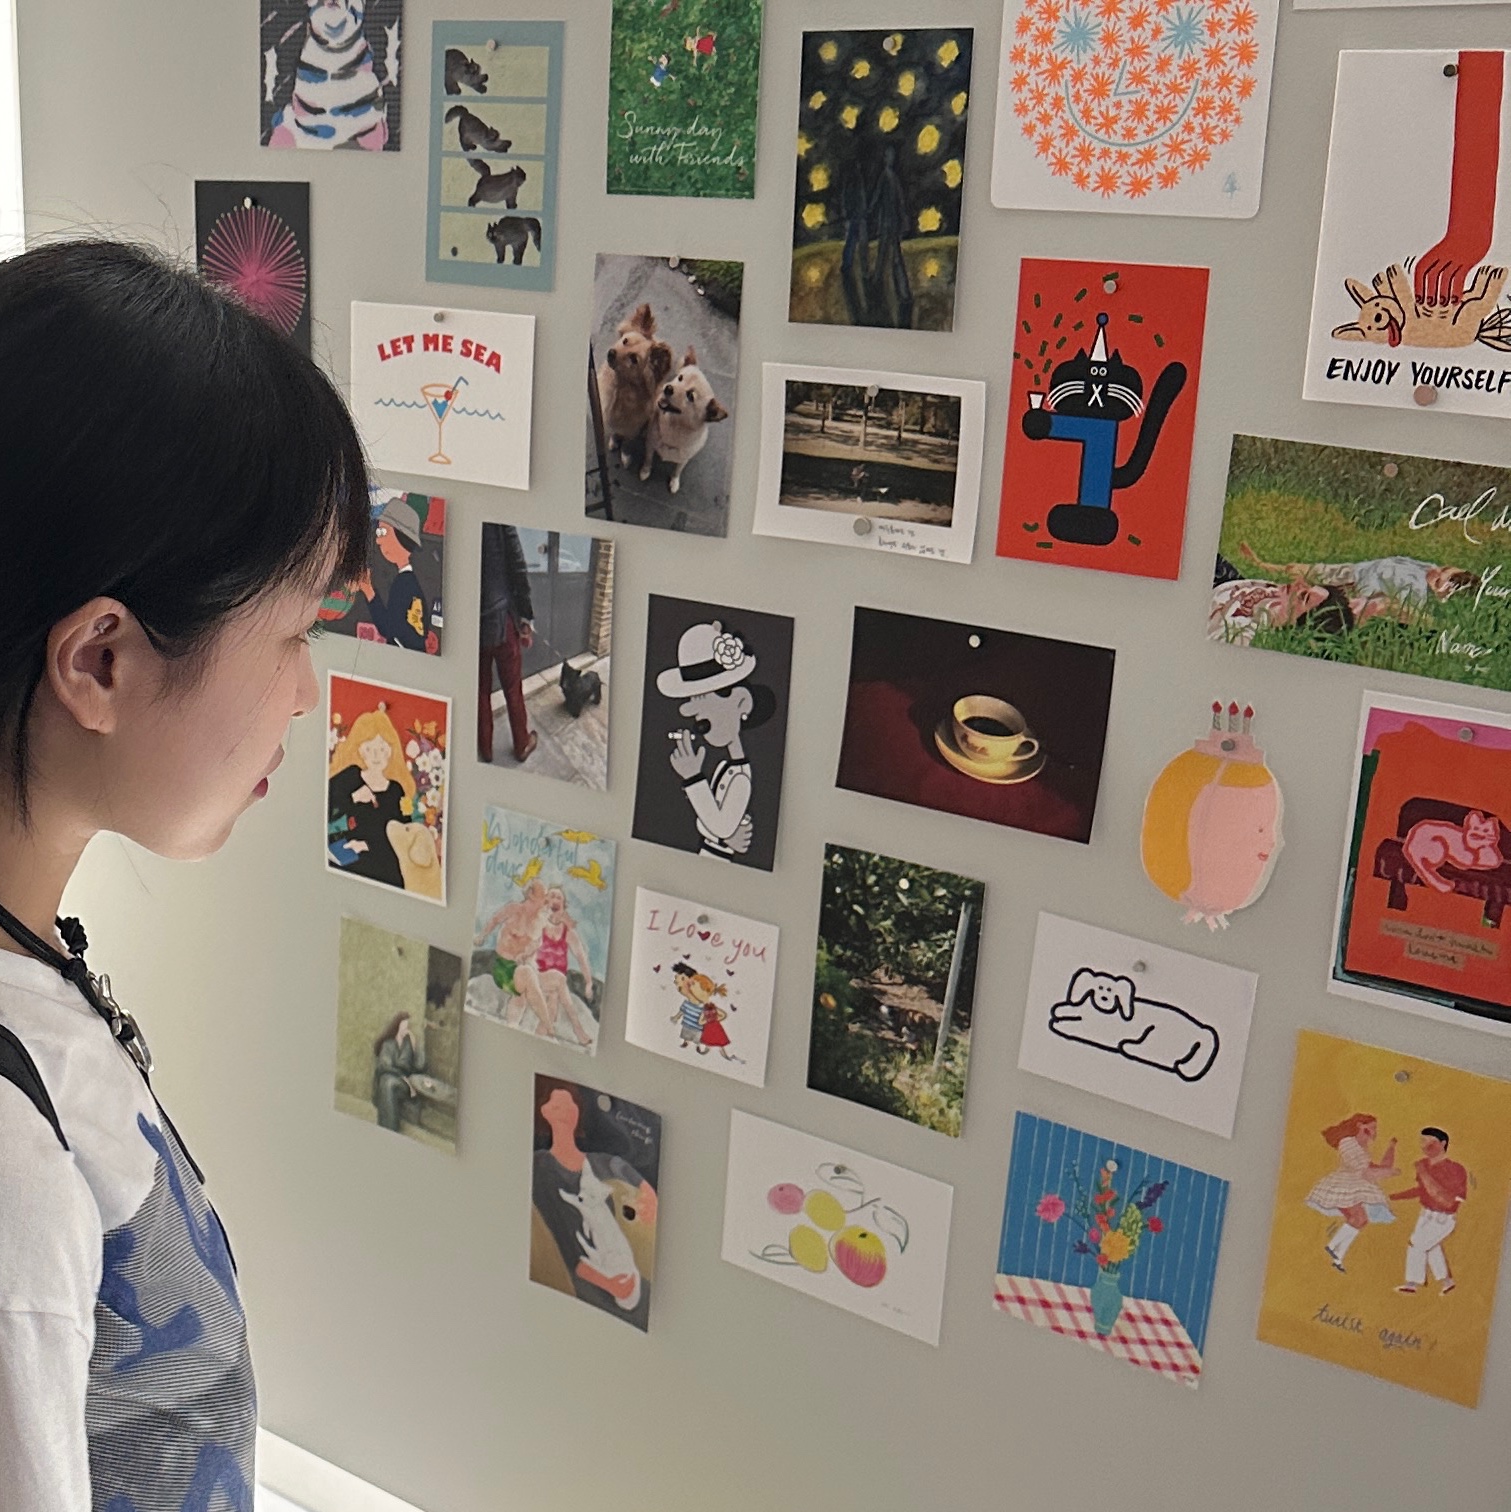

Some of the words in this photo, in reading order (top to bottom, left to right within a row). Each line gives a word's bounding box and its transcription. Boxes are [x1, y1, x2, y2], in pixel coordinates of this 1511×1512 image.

[617, 111, 679, 150] Sunny
[687, 114, 724, 151] day
[629, 141, 670, 165] with
[377, 334, 415, 362] LET
[422, 333, 454, 354] ME
[459, 338, 502, 375] SEA
[1326, 357, 1401, 386] ENJOY
[1411, 361, 1511, 394] YOURSELF
[647, 909, 660, 931] I
[723, 938, 767, 965] you
